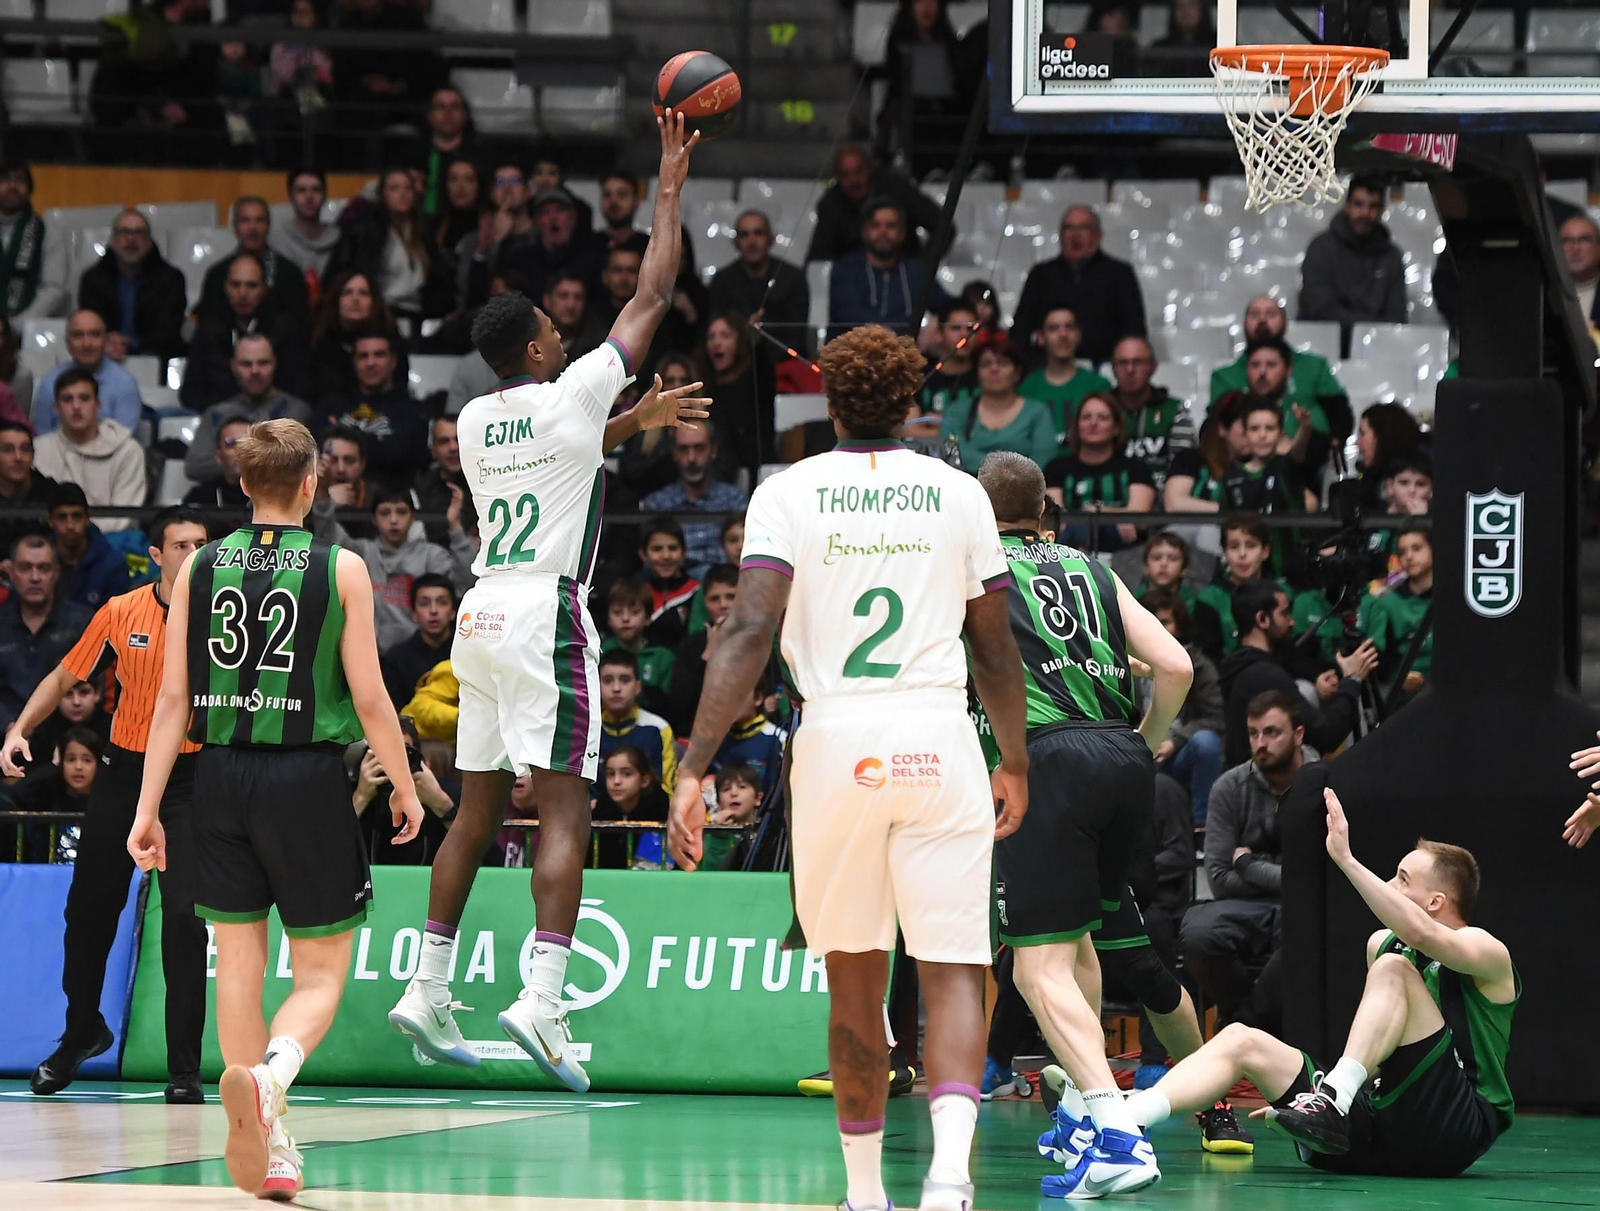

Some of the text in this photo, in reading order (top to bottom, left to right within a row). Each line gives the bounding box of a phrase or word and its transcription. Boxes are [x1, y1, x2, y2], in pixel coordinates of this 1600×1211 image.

[1041, 45, 1073, 64] liga
[1041, 61, 1109, 78] endesa
[485, 417, 534, 448] EJIM
[816, 484, 941, 514] THOMPSON
[485, 493, 540, 567] 22
[212, 547, 310, 572] ZAGARS
[476, 611, 505, 622] COSTA
[1029, 571, 1102, 642] 81
[208, 586, 299, 673] 32
[474, 622, 503, 632] DEL SOL
[843, 587, 904, 679] 2
[266, 696, 302, 712] FUTUR
[892, 754, 940, 765] COSTA
[892, 767, 941, 777] DEL SOL
[646, 936, 829, 993] FUTUR
